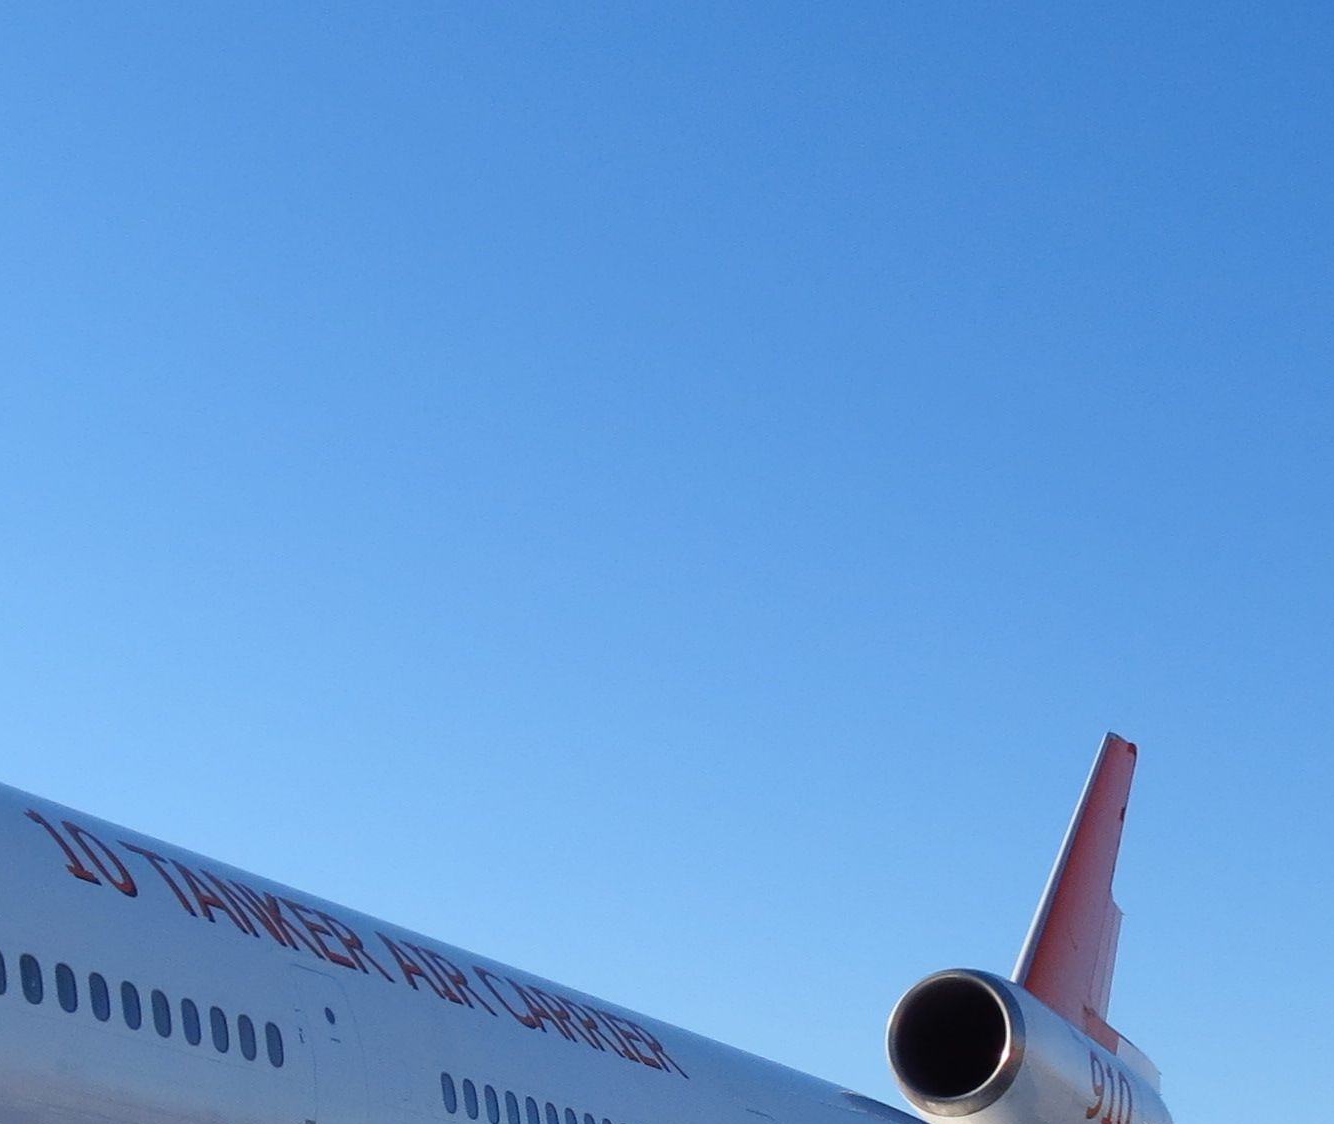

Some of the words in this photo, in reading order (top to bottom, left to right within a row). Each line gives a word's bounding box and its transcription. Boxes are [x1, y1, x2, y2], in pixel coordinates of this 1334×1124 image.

[23, 808, 138, 898] 10
[117, 839, 396, 984] TANKER
[374, 931, 499, 1017] AIR
[472, 966, 690, 1080] CARRIER
